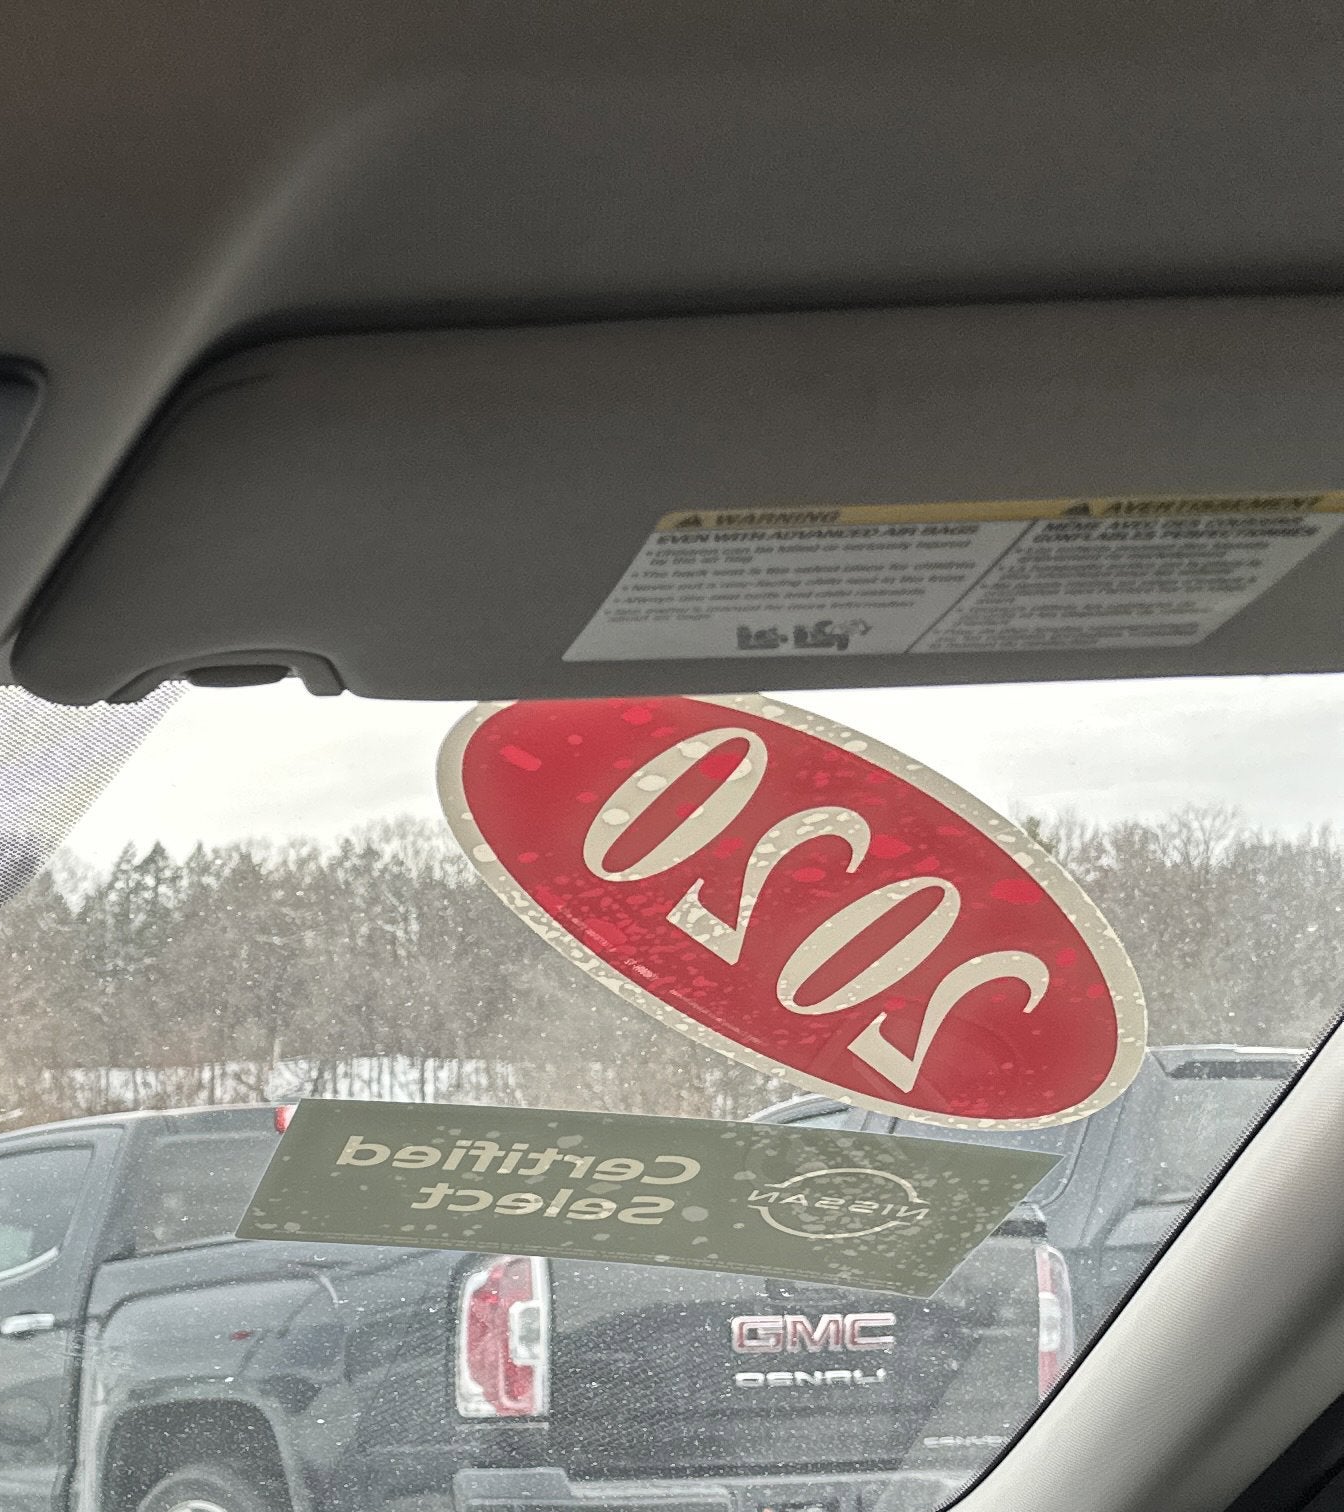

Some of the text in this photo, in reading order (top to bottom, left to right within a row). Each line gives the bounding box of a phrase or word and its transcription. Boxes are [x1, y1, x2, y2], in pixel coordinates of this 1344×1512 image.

[715, 510, 840, 526] WARNING
[731, 1312, 897, 1353] GMC
[734, 1367, 887, 1388] DENALI
